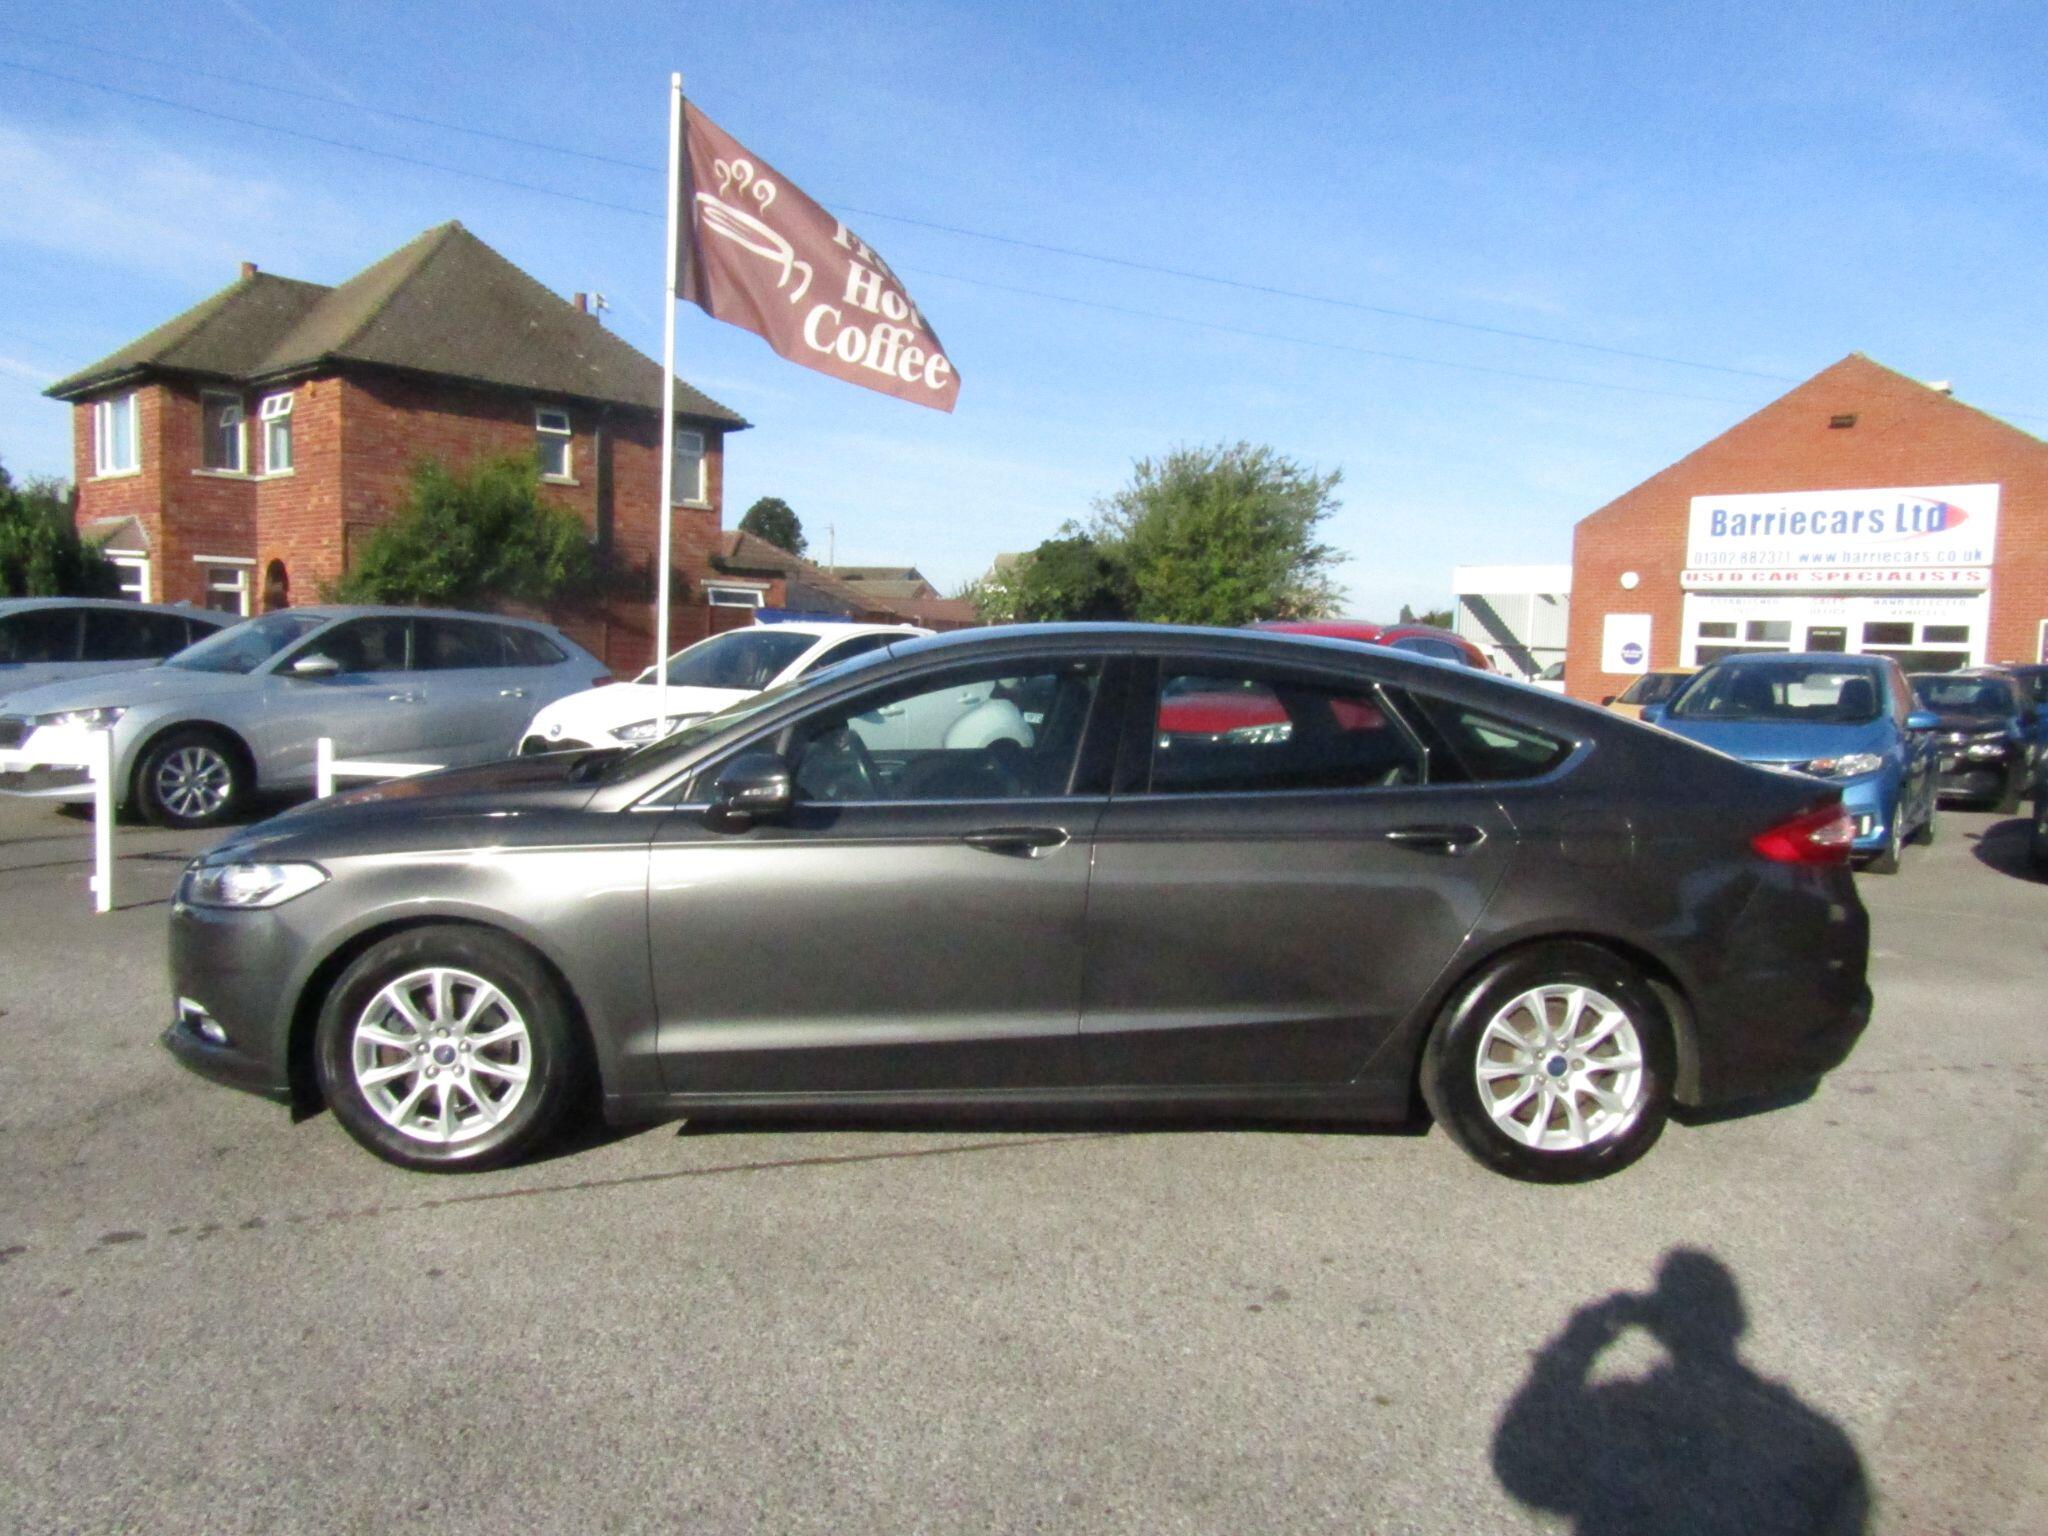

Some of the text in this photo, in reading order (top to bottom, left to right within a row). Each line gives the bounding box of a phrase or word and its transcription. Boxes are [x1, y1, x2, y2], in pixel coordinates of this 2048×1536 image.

[803, 304, 950, 389] Coffee
[1710, 502, 1949, 537] Barriecars Ltd
[1798, 547, 1982, 564] wwwbarriecarscouk
[1685, 571, 1982, 582] USED CAR SPECIALISTS
